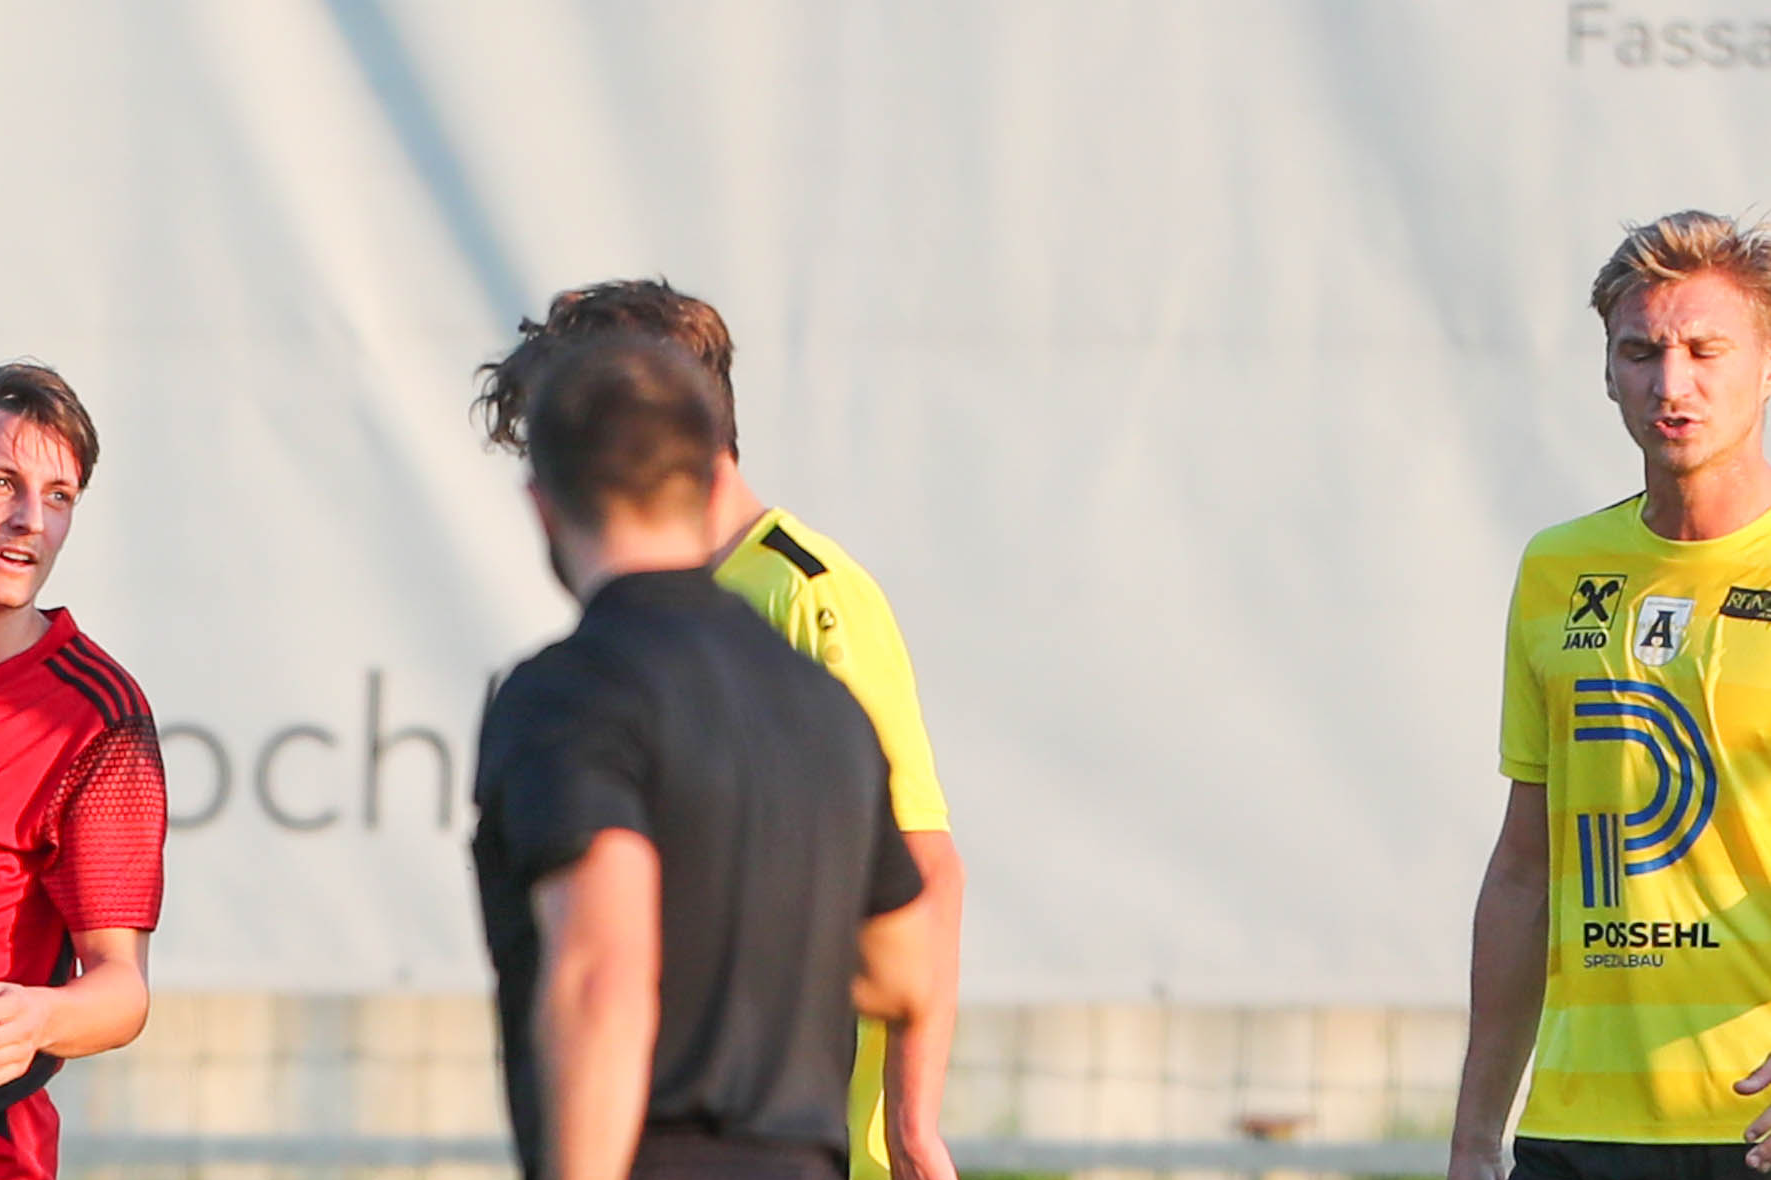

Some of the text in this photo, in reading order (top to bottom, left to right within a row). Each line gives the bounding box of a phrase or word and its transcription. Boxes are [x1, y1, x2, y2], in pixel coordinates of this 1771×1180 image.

[1562, 631, 1607, 650] JAKO
[163, 668, 500, 830] och
[1583, 921, 1720, 949] POSSEHL
